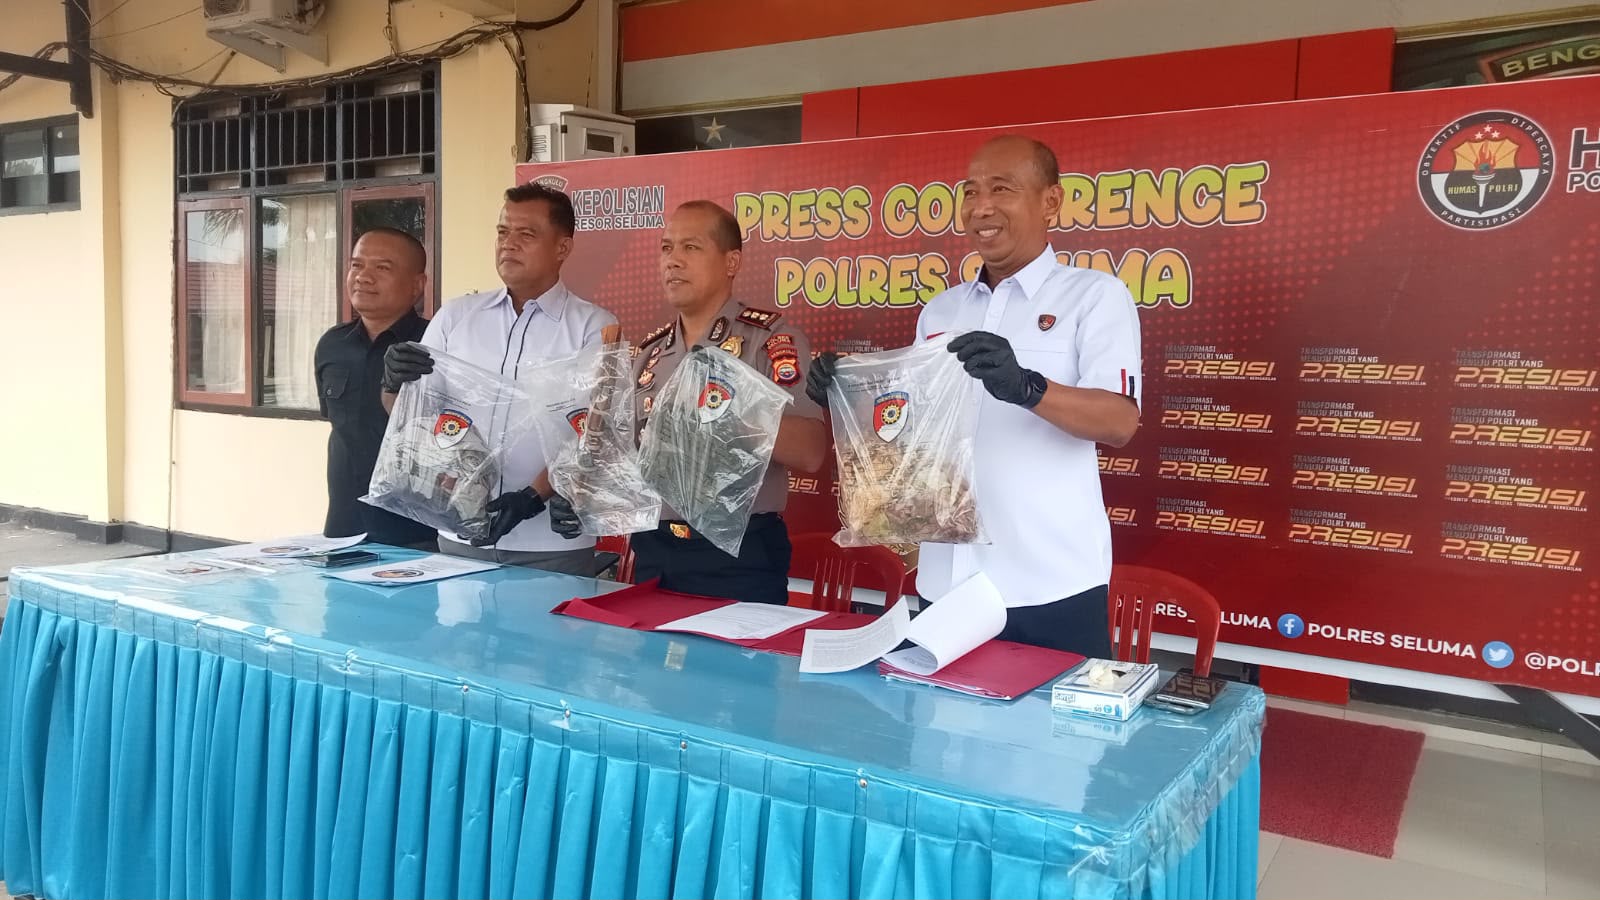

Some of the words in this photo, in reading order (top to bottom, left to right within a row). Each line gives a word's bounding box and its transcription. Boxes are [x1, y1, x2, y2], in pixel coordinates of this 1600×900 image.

[1422, 123, 1461, 176] OBYEKTIF
[1511, 117, 1550, 175] DIPERCAYA
[1447, 185, 1477, 195] HUMAS
[1488, 183, 1518, 193] POLRI
[572, 186, 664, 216] KEPOLISIAN
[734, 185, 872, 243] PRESS
[881, 160, 1269, 238] CORENCE
[575, 217, 612, 231] RESOR
[614, 214, 664, 229] SELUMA
[1441, 207, 1522, 227] PARTISIPASI
[775, 252, 950, 308] POLRES
[1165, 345, 1216, 353] TRANSFORMASI
[1456, 351, 1520, 359] TRANSFORMASI
[1164, 360, 1275, 377] PRESISI
[1300, 363, 1425, 381] PRESISI
[1520, 360, 1543, 368] YANG
[1454, 367, 1597, 386] PRESISI
[1162, 396, 1213, 404] TRANSFORMASI
[1297, 401, 1355, 409] TRANSFORMASI
[1161, 410, 1272, 429] PRESISI
[1451, 407, 1516, 417] TRANSFORMASI
[1296, 417, 1420, 436] PRESISI
[1487, 417, 1513, 425] POLRI
[1450, 424, 1591, 446] PRESISI
[1160, 447, 1210, 456] TRANSFORMASI
[1187, 455, 1207, 463] POLRI
[1293, 455, 1350, 465] TRANSFORMASI
[1158, 461, 1268, 481] PRESISI
[1446, 464, 1511, 476] TRANSFORMASI
[1292, 470, 1416, 492] PRESISI
[1482, 475, 1508, 484] POLRI
[1510, 478, 1533, 486] YANG
[1157, 497, 1207, 507] TRANSFORMASI
[1445, 481, 1586, 506] PRESISI
[1206, 508, 1224, 516] YANG
[1290, 508, 1346, 519] TRANSFORMASI
[1155, 511, 1264, 535] PRESISI
[1321, 519, 1344, 527] POLRI
[1346, 521, 1366, 529] YANG
[1443, 522, 1506, 534] TRANSFORMASI
[1289, 524, 1412, 549] PRESISI
[1478, 533, 1502, 542] POLRI
[1505, 536, 1528, 544] YANG
[1440, 538, 1580, 566] PRESISI
[1308, 622, 1385, 645] POLRES
[1390, 634, 1476, 659] SELUMA
